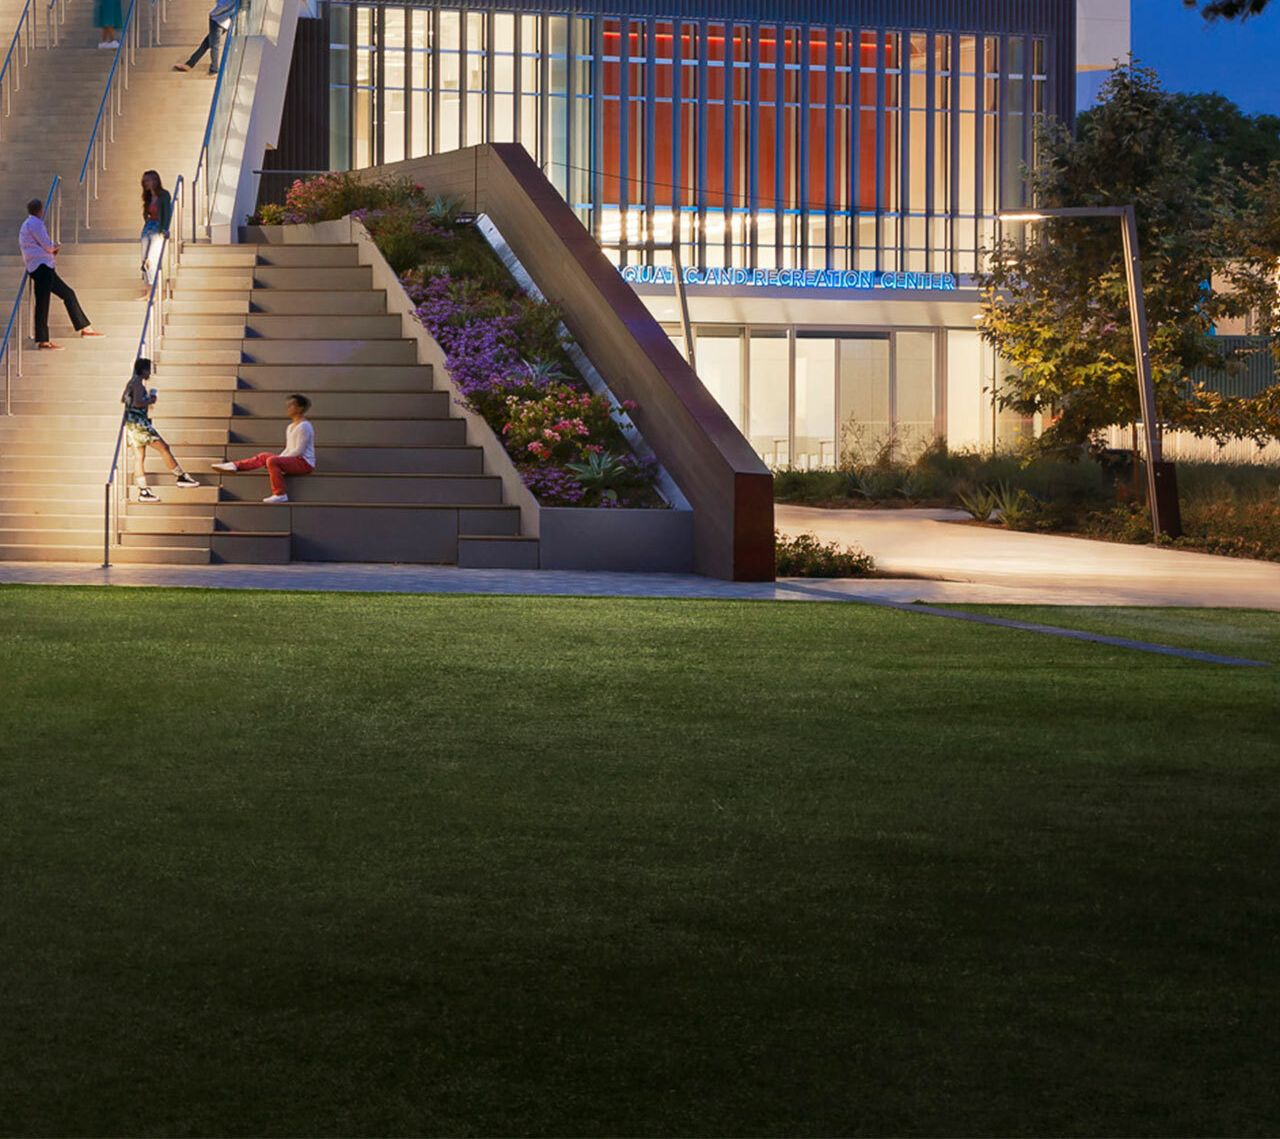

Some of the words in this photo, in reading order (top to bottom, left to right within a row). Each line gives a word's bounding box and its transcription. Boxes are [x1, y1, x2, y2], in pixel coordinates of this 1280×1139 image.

[616, 265, 700, 285] QUATC
[702, 267, 749, 287] AND
[751, 268, 874, 290] RECREATION
[880, 270, 956, 292] CENTER
